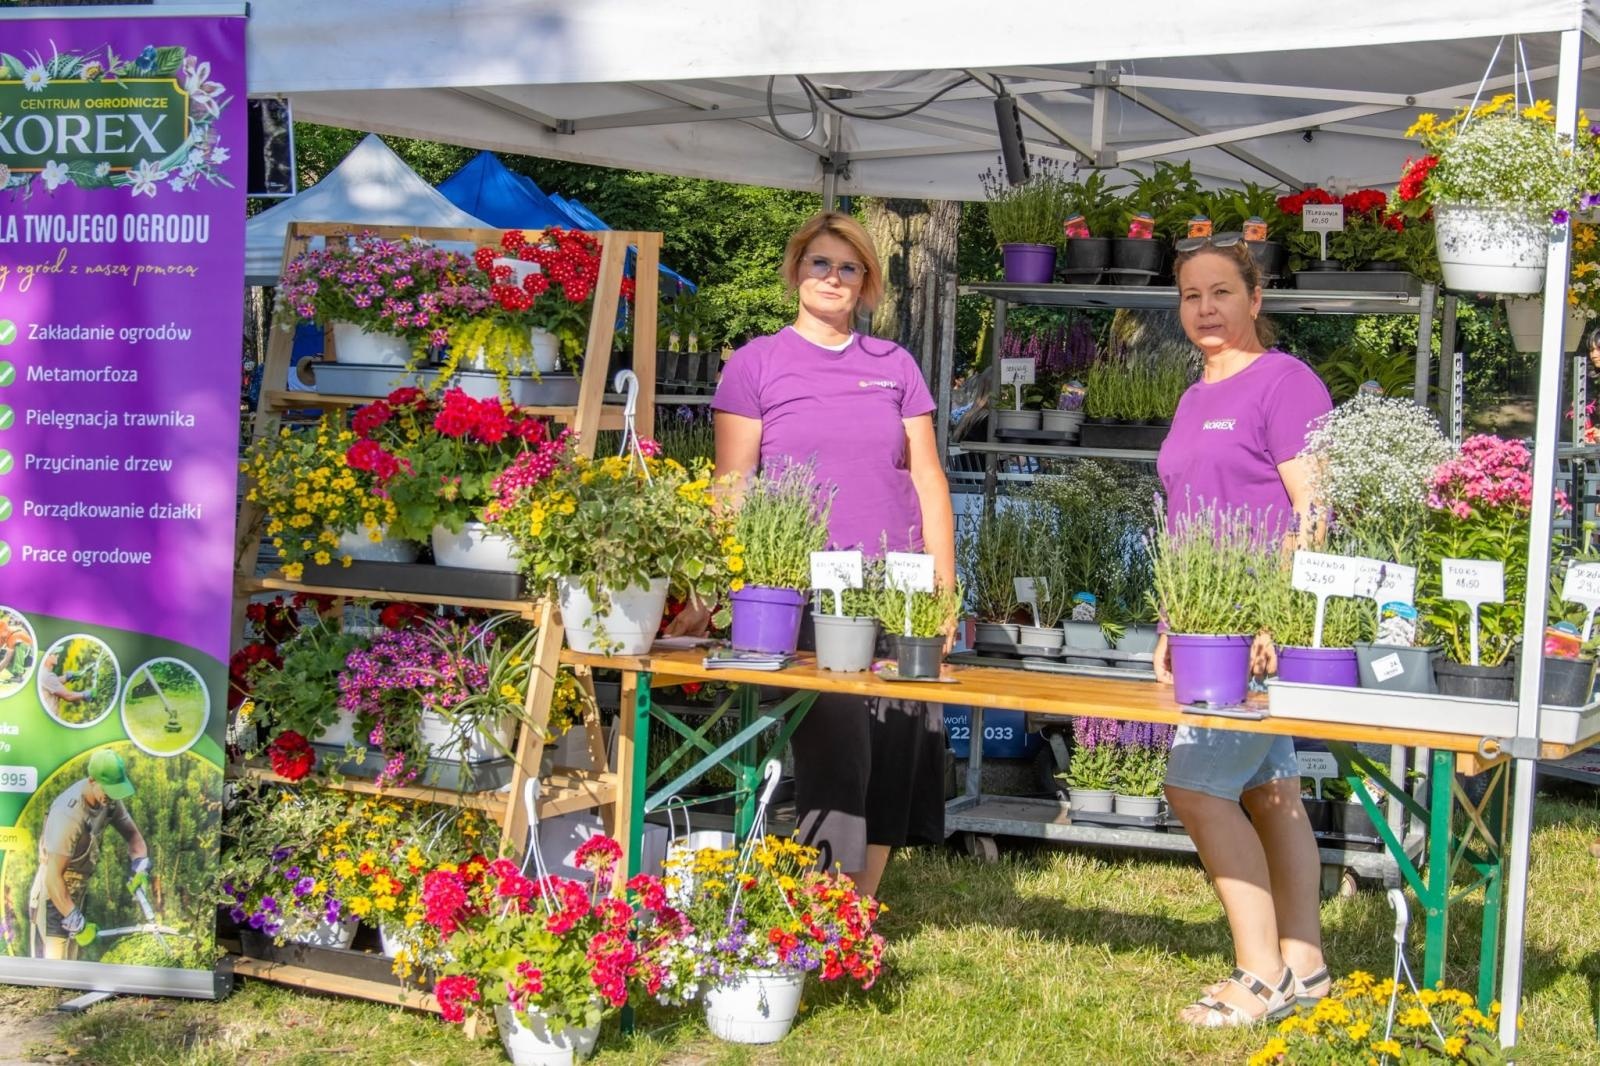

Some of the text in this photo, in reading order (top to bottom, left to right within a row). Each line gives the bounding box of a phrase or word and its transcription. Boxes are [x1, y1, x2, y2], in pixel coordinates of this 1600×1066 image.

[21, 97, 169, 110] CENTRUM OGRODNICZE
[24, 214, 118, 243] TWOJEGO
[123, 213, 210, 243] OGRODU
[17, 247, 67, 292] ogród
[70, 264, 78, 275] z
[85, 263, 130, 276] naszą
[133, 263, 198, 287] pomocą
[28, 322, 192, 344] Zakładanie ogrodów
[26, 365, 138, 383] Metamorfoza
[26, 409, 195, 429] Pielęgnacja trawnika
[25, 454, 173, 474] Przycinanie drzew
[23, 500, 202, 521] Porządkowanie działki
[22, 545, 152, 567] Prace ogrodowe
[1299, 556, 1346, 571] LAWENDA
[1304, 571, 1336, 585] 32,50
[1448, 566, 1478, 576] FLOKS
[984, 727, 1013, 740] 033
[0, 772, 27, 787] 995
